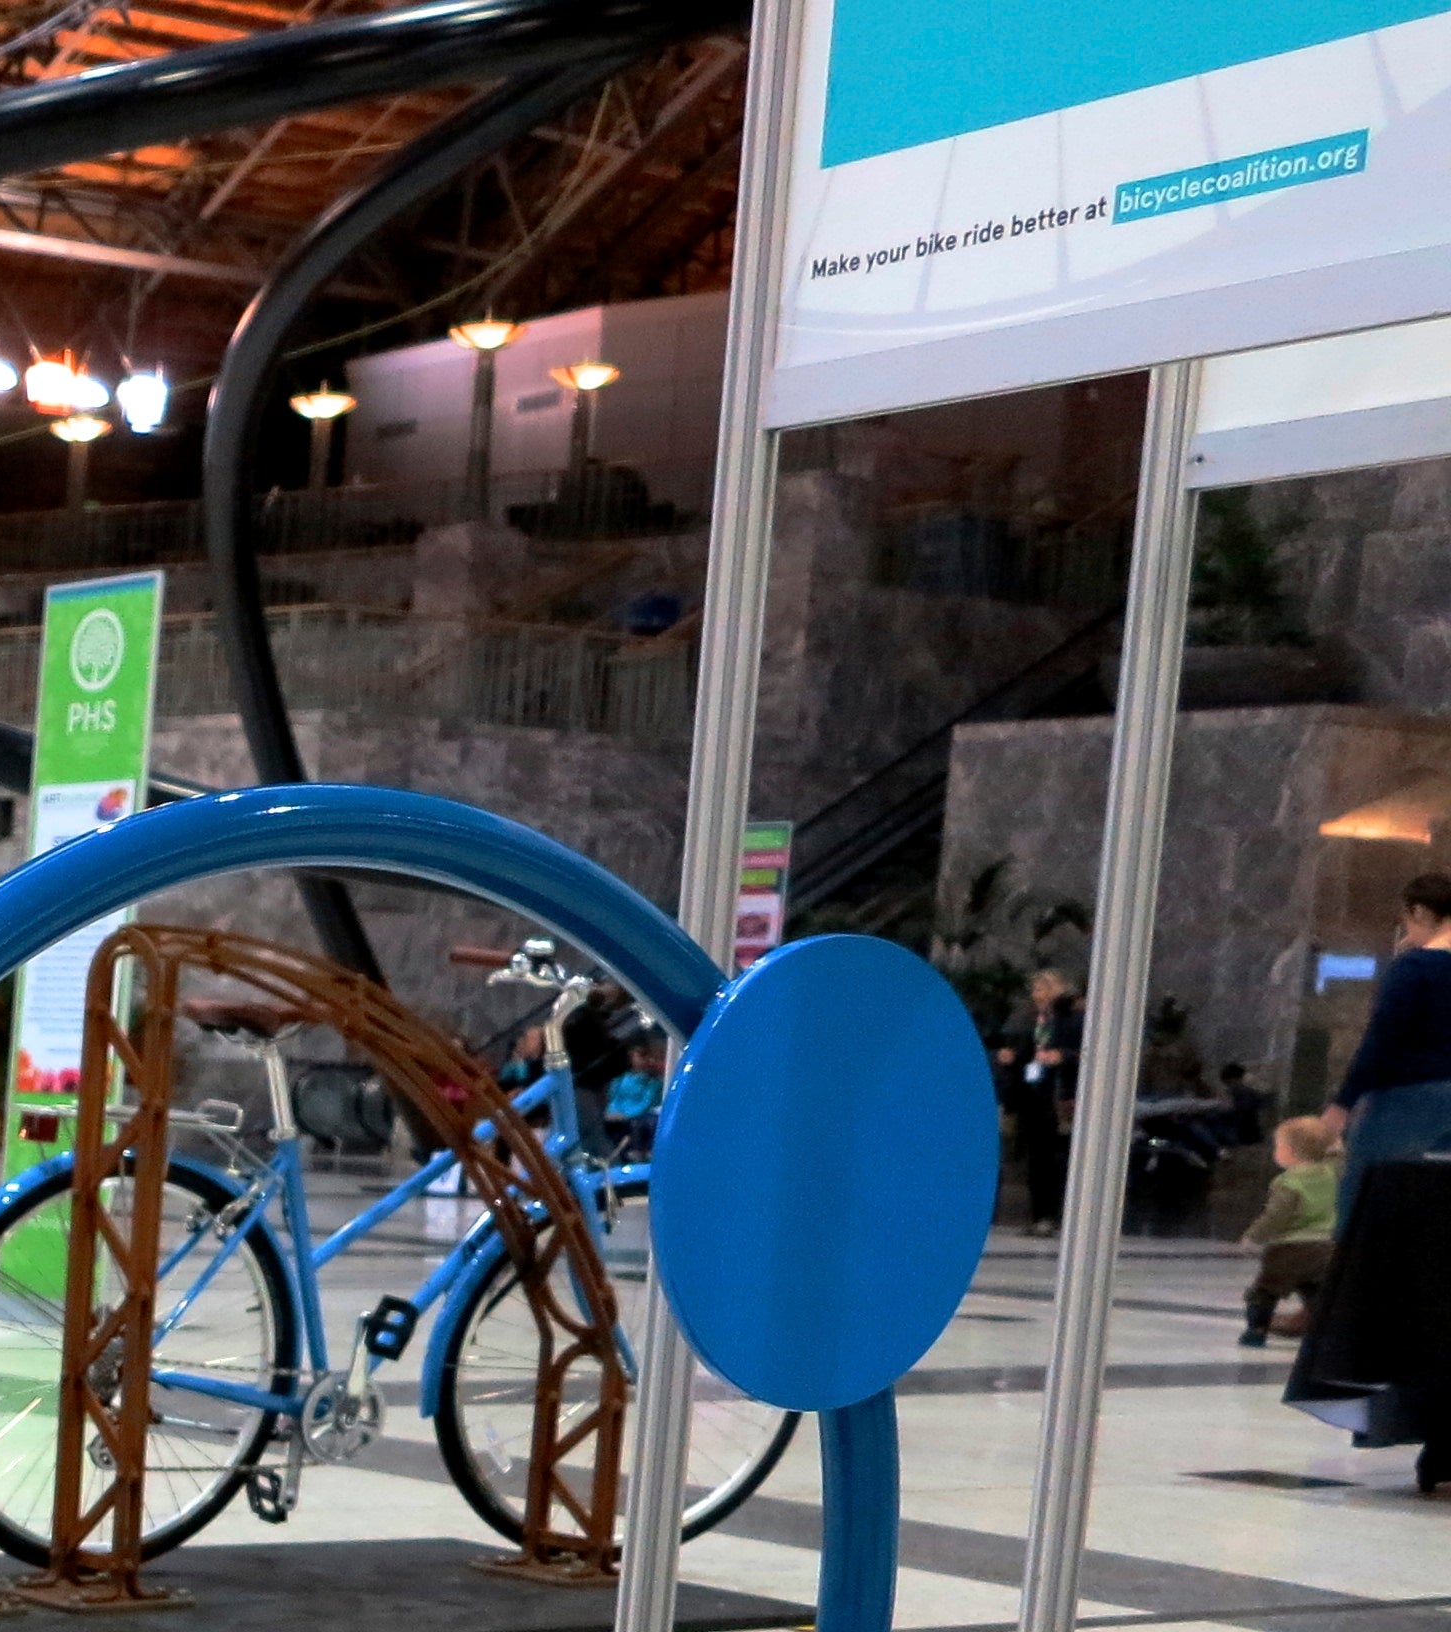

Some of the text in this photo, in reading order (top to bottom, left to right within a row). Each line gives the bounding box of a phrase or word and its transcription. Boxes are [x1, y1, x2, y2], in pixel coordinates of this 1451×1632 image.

[811, 143, 1361, 280] Make your bike ride better at bicyclecoalition.org
[66, 699, 117, 734] PHS
